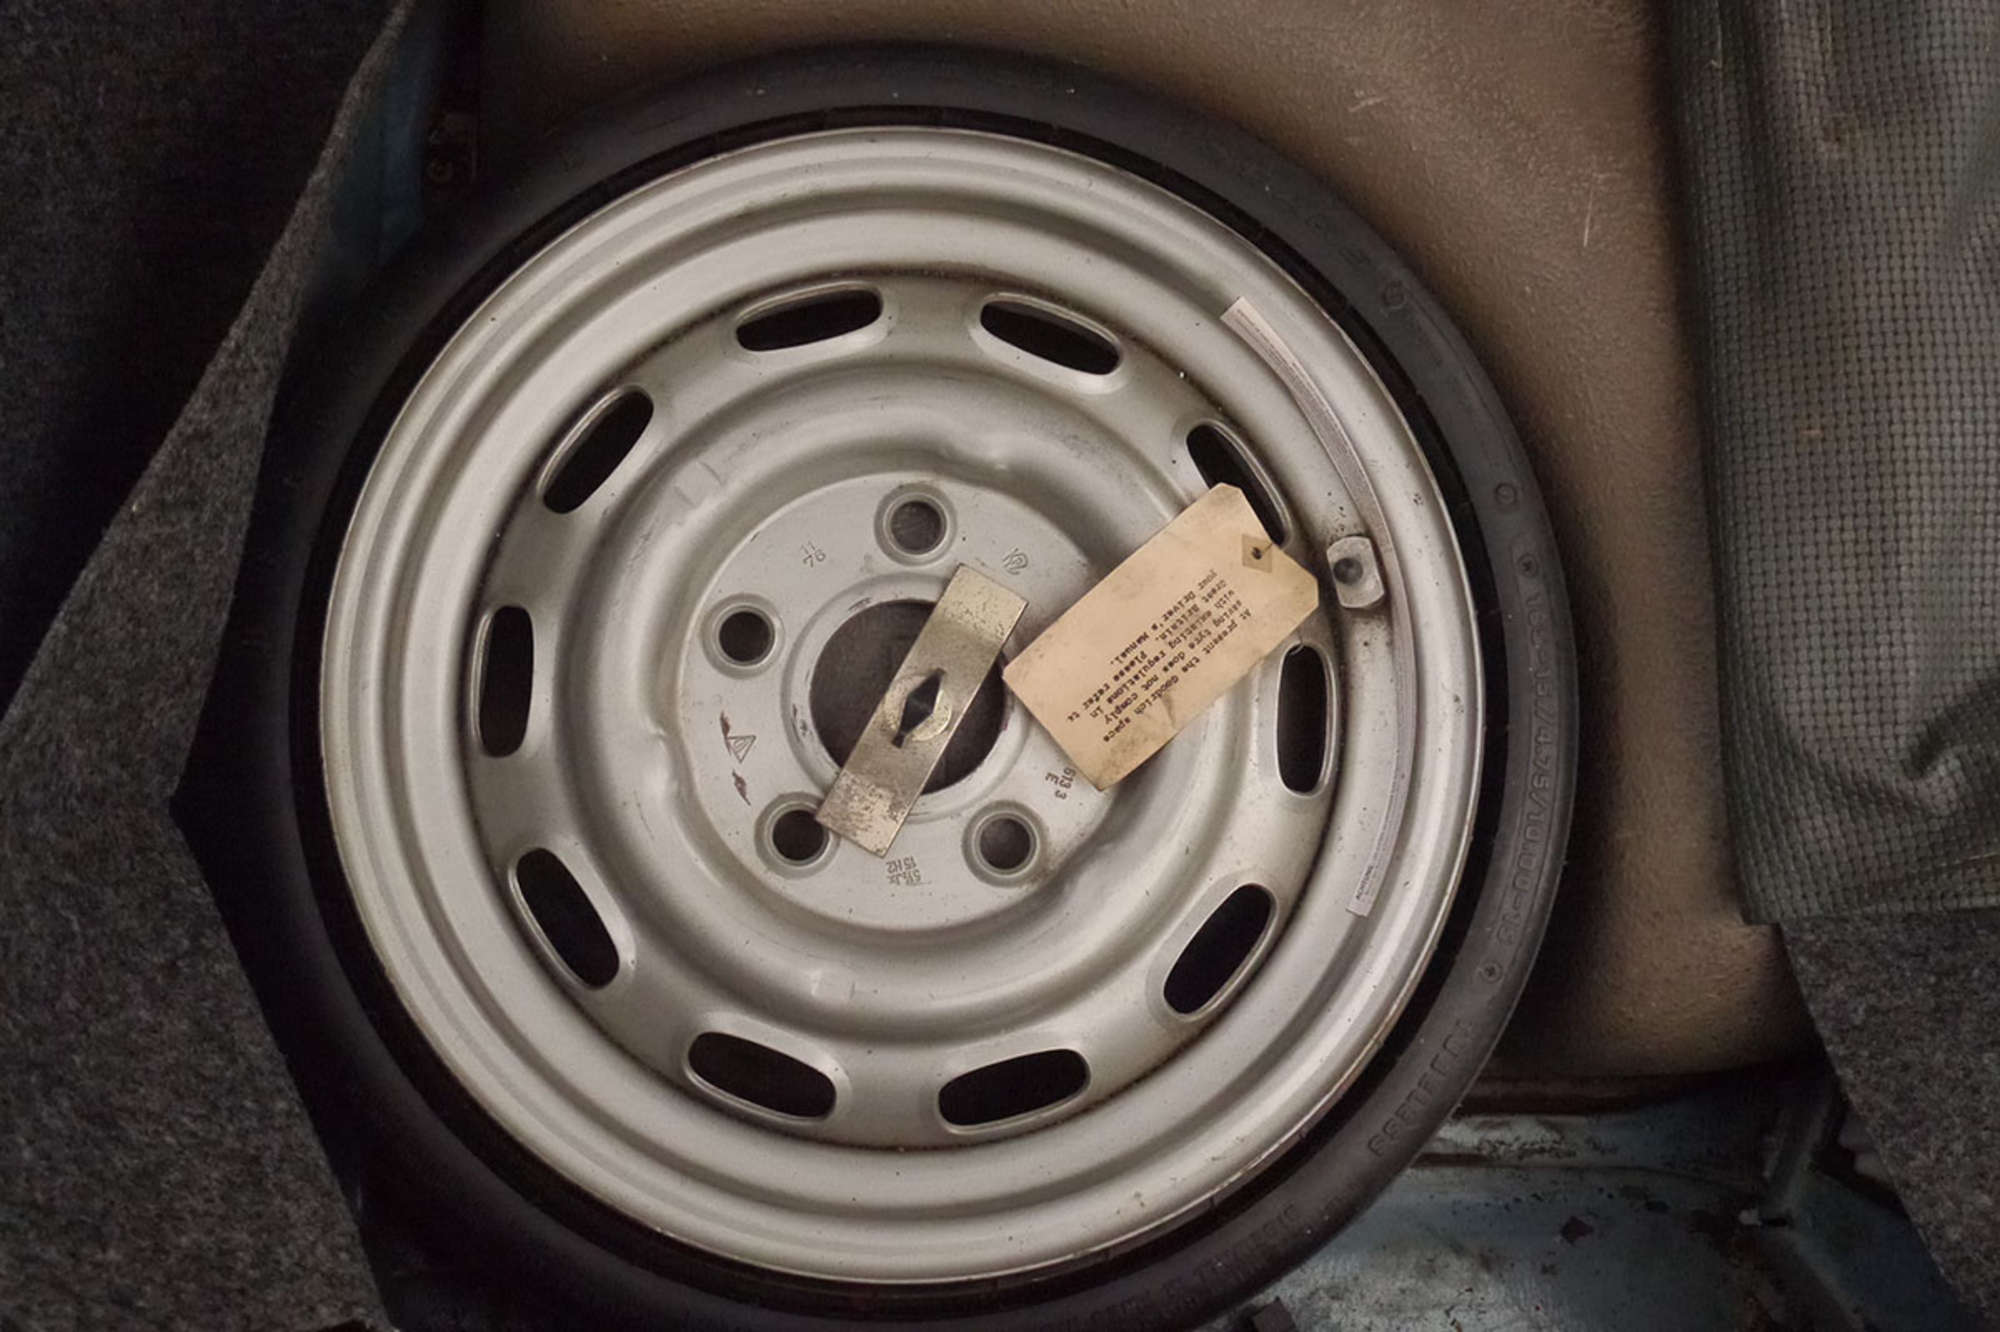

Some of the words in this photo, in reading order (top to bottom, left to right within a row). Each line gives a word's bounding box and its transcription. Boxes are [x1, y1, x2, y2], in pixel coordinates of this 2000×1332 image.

[1195, 569, 1218, 590] your
[1201, 579, 1227, 603] Great
[1150, 591, 1196, 633] Driver's
[1212, 599, 1243, 627] saving
[1214, 589, 1236, 610] with
[1240, 609, 1251, 621] At
[1167, 608, 1213, 650] existing
[1186, 627, 1211, 650] tyre
[1200, 620, 1238, 655] present
[1110, 632, 1150, 668] Manual.
[1162, 651, 1186, 673] does
[1105, 649, 1167, 705] regulations
[1112, 650, 1148, 683] Please
[1181, 656, 1201, 675] the
[1134, 675, 1179, 716] Goodrich
[1141, 674, 1159, 691] not
[1082, 683, 1111, 710] refer
[1102, 691, 1139, 726] comply
[1090, 706, 1104, 719] in
[1102, 715, 1131, 743] space
